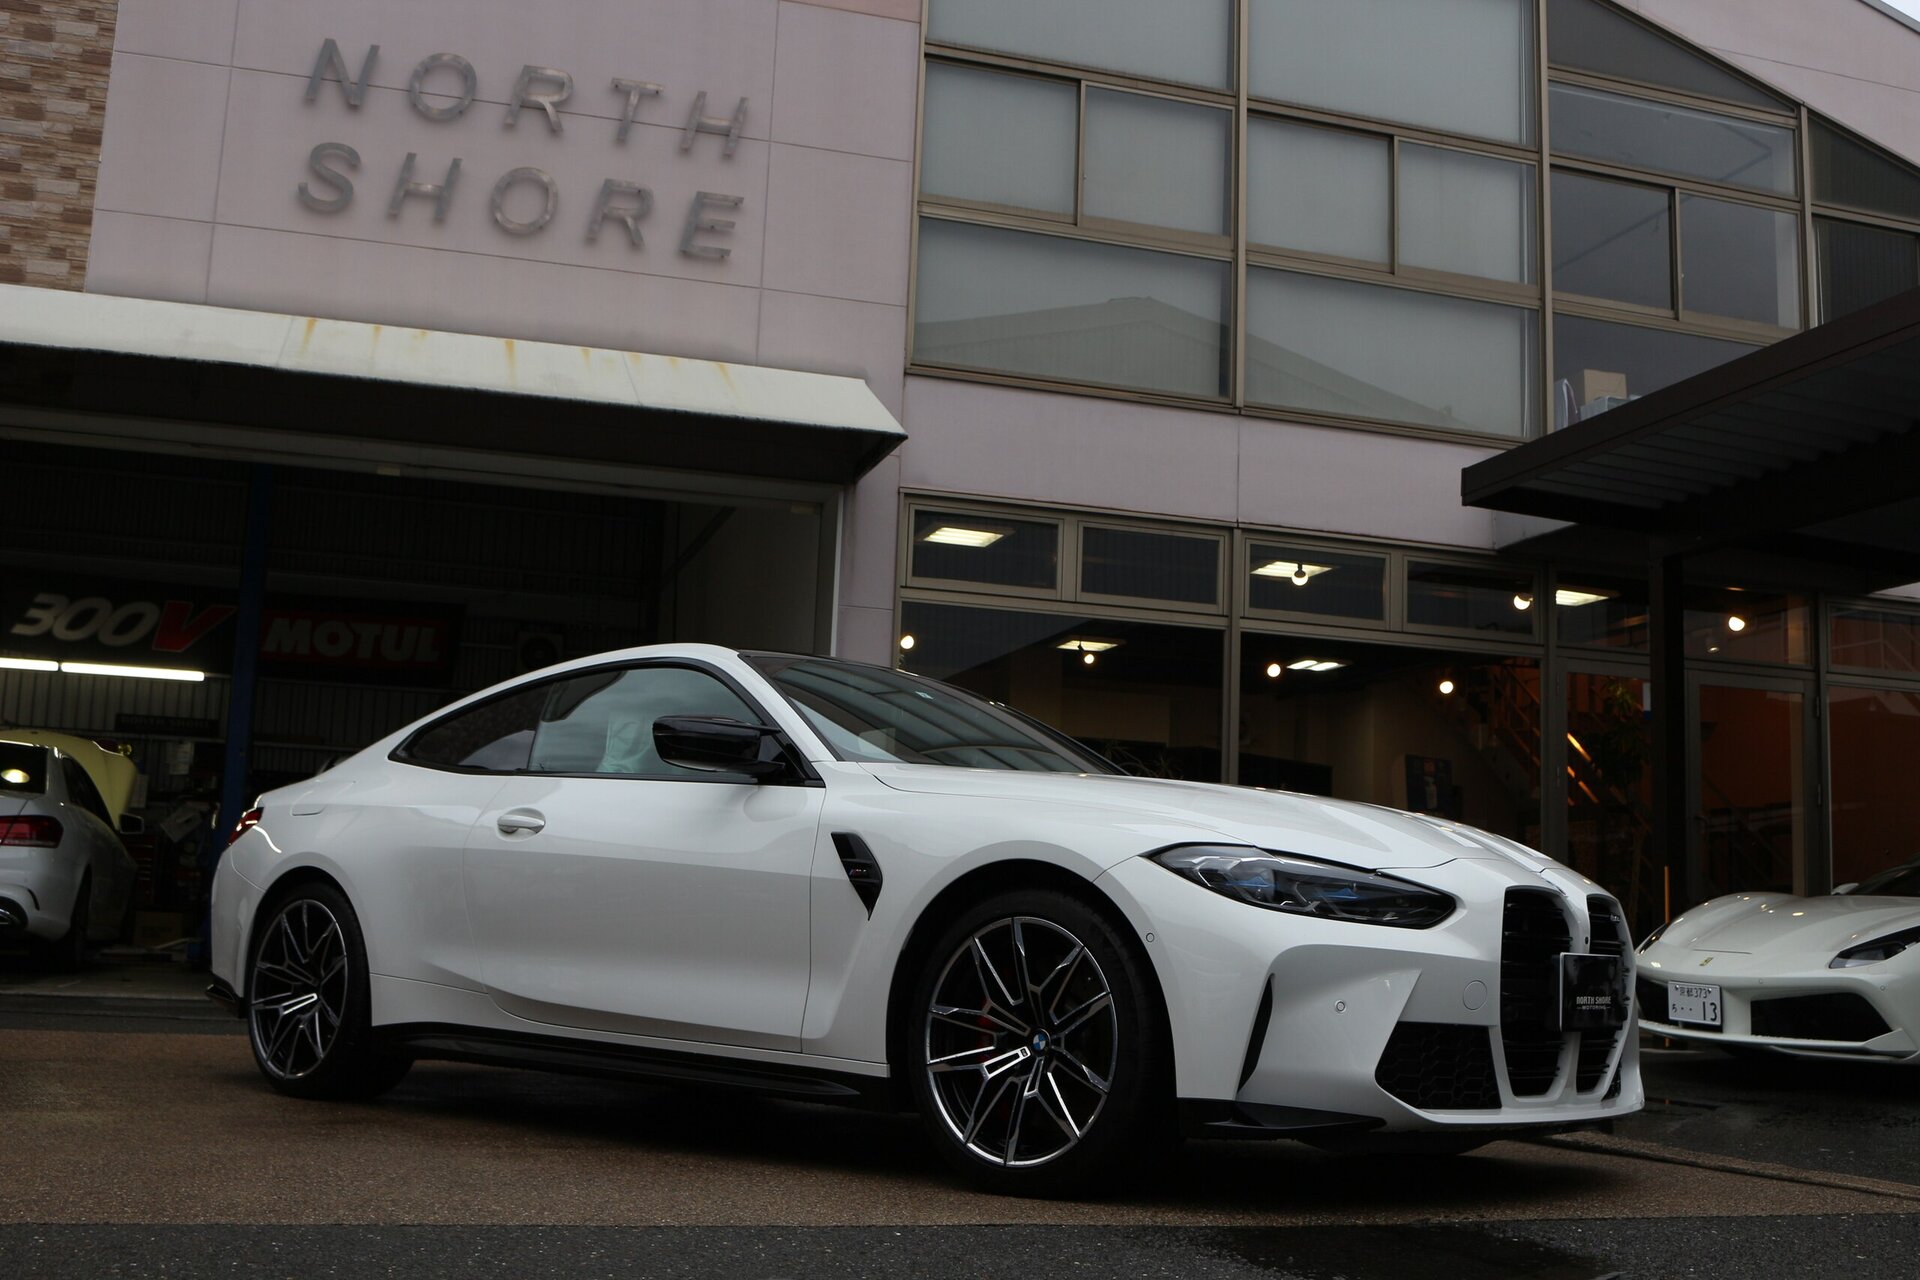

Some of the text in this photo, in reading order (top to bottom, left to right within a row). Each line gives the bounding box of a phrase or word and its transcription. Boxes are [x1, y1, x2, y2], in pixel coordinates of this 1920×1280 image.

[304, 38, 748, 158] NORTH
[298, 142, 745, 259] SHORE
[10, 592, 239, 653] 300V
[261, 617, 440, 663] MOTUL
